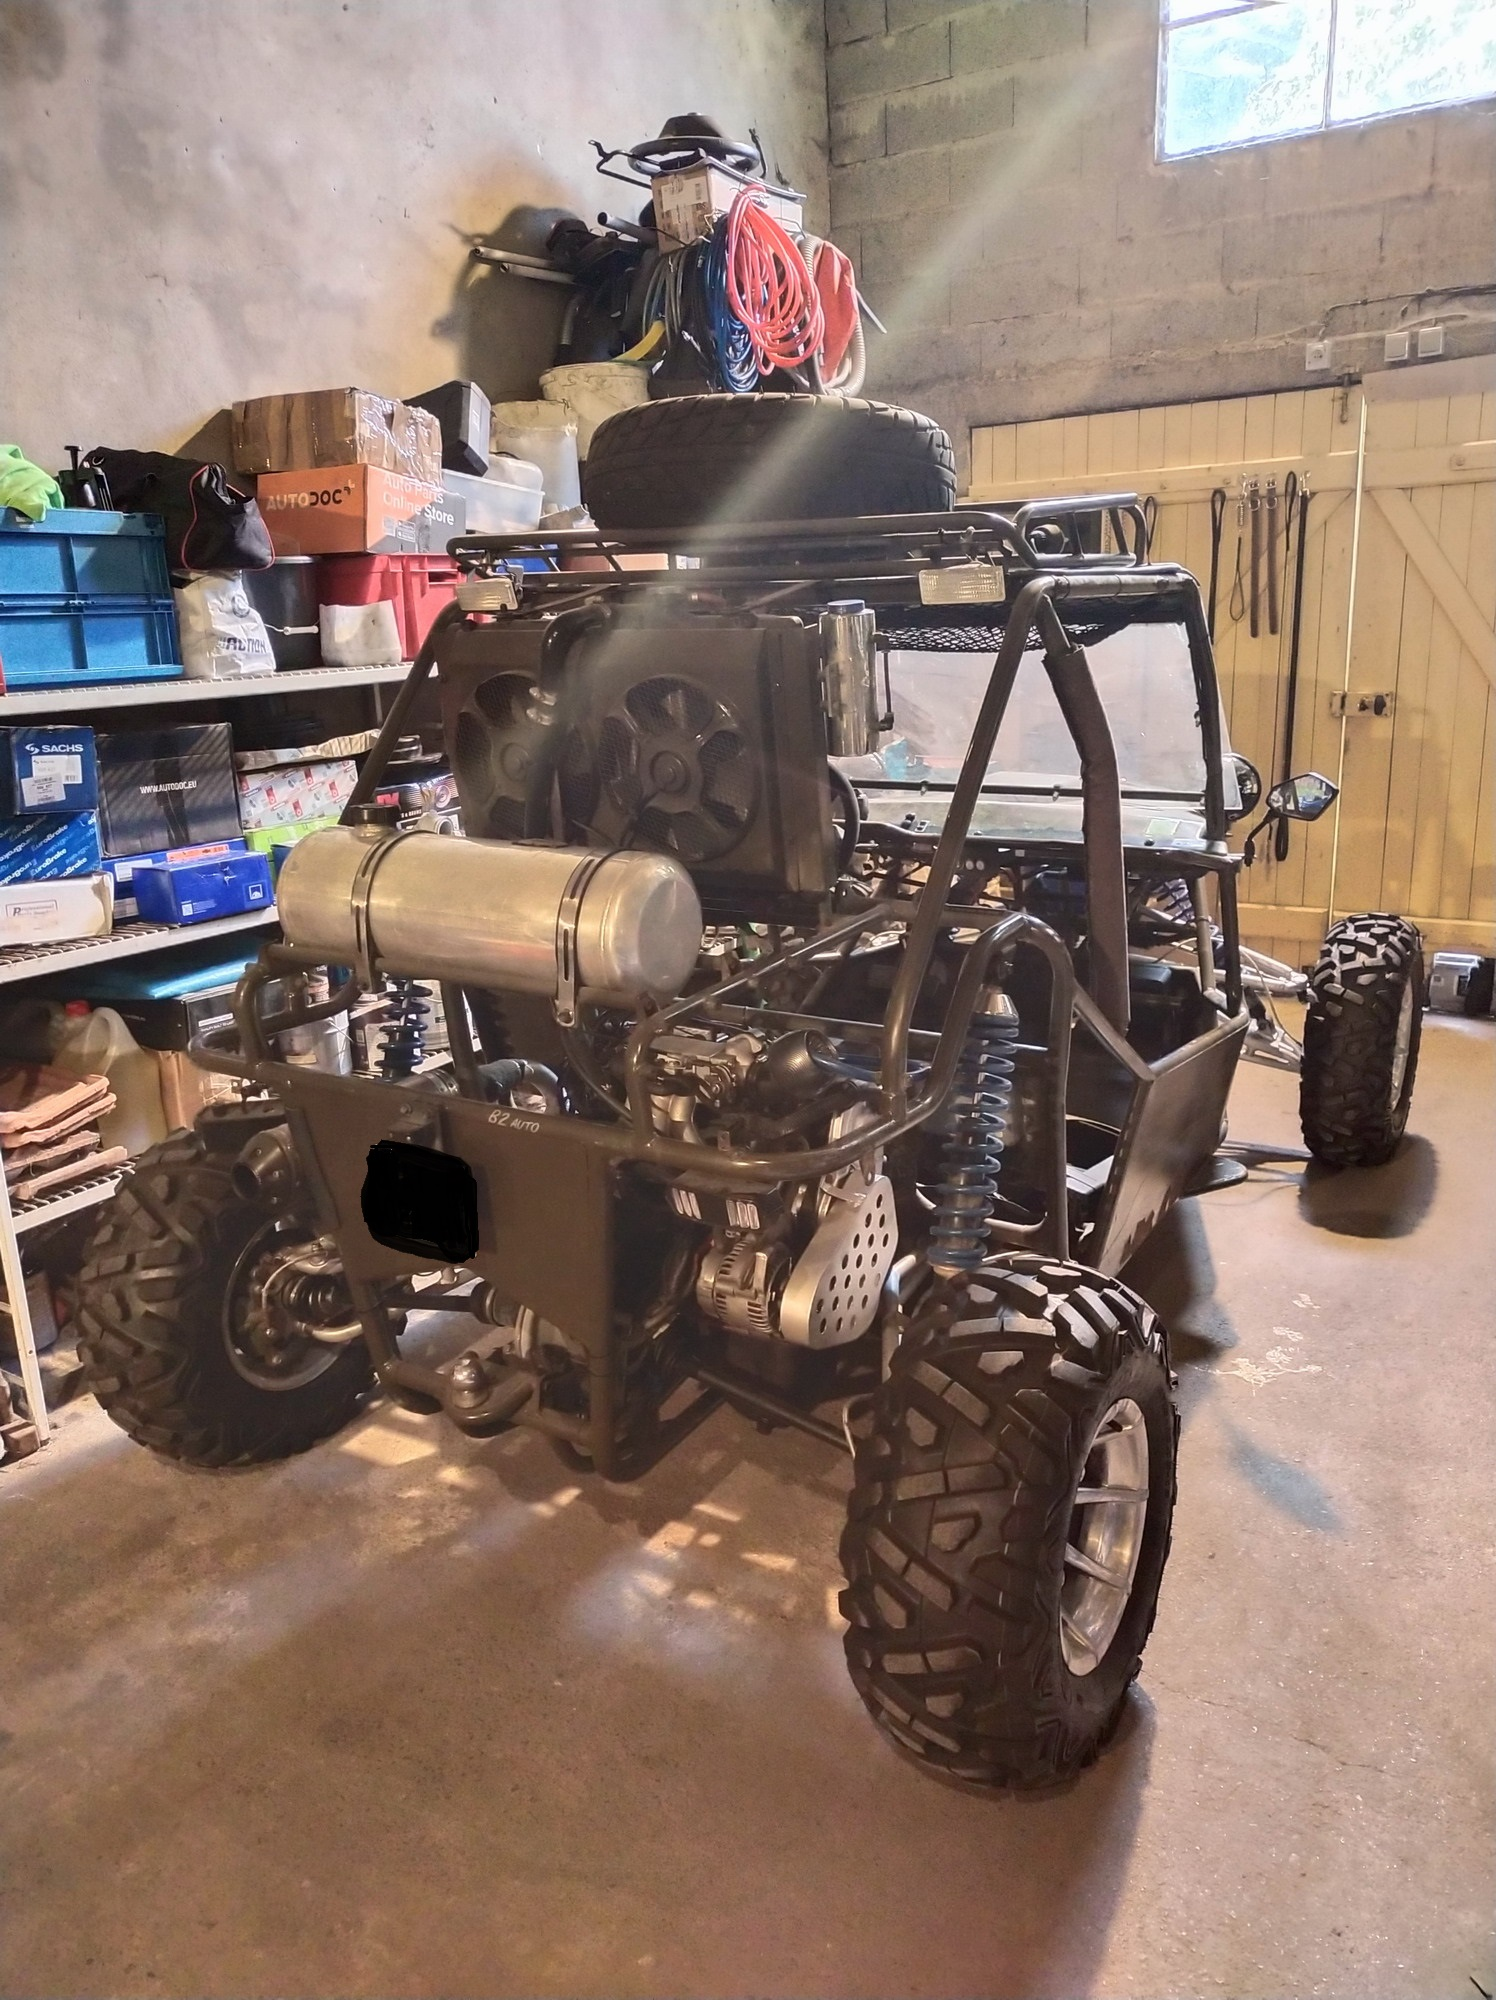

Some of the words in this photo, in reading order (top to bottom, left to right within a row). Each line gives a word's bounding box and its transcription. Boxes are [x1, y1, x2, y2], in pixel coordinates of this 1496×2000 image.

[266, 488, 343, 512] AUTODOC
[384, 473, 411, 493] Auto
[415, 483, 444, 504] Parts
[383, 492, 422, 516] Online
[424, 504, 455, 526] Store
[41, 744, 84, 753] SACHS
[140, 780, 197, 794] WWW.AUTODOC.EU
[31, 825, 69, 852] EuroBrake
[30, 848, 67, 876] EuroBrake
[488, 1109, 510, 1127] B2
[510, 1118, 540, 1133] AUTO
